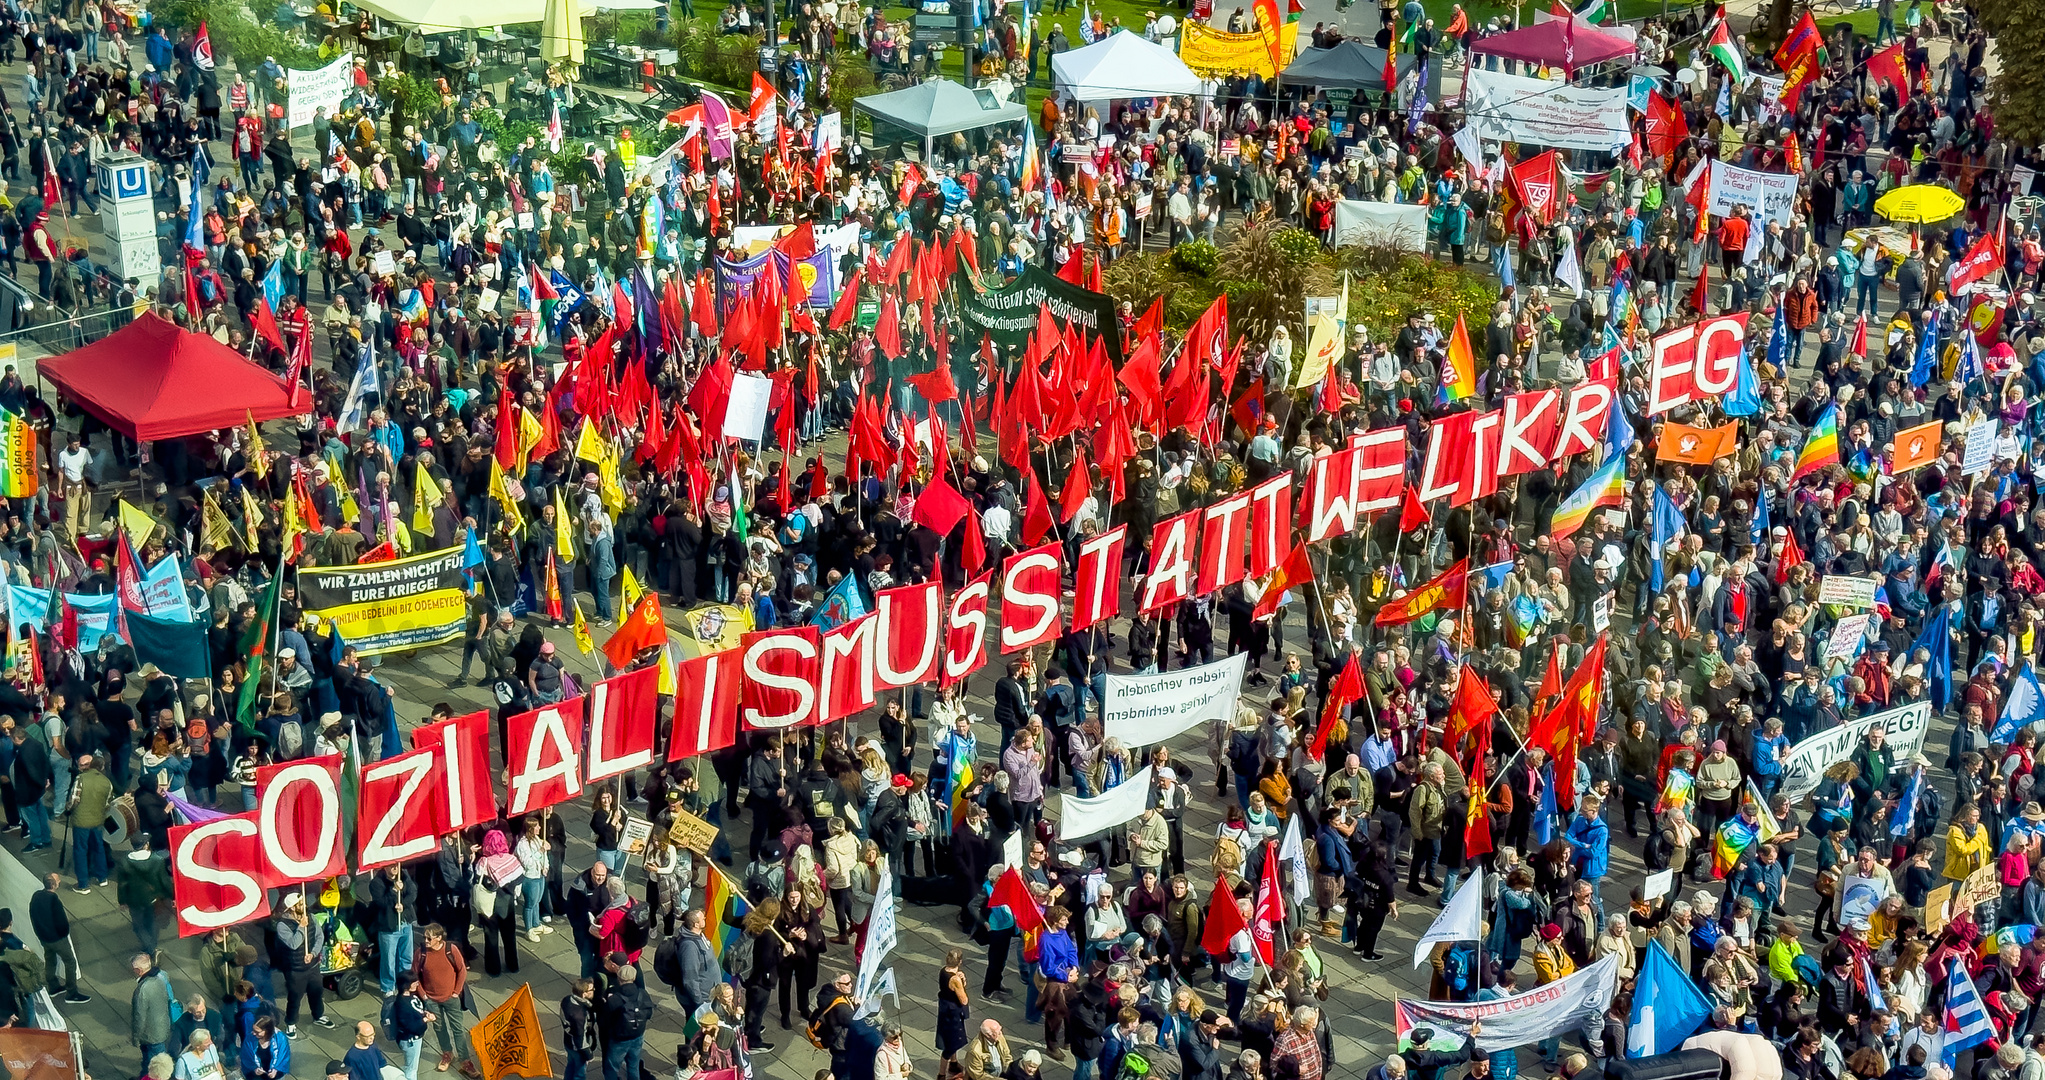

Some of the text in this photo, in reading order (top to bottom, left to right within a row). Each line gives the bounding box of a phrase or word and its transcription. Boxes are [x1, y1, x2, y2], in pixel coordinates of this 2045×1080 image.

[1255, 4, 1277, 46] MLPD
[121, 169, 142, 191] U
[742, 263, 767, 276] kämp
[318, 575, 348, 590] WIR
[348, 569, 401, 588] ZAHLEN
[402, 561, 443, 580] NICHT
[352, 577, 439, 603] EURE KRIEGE!
